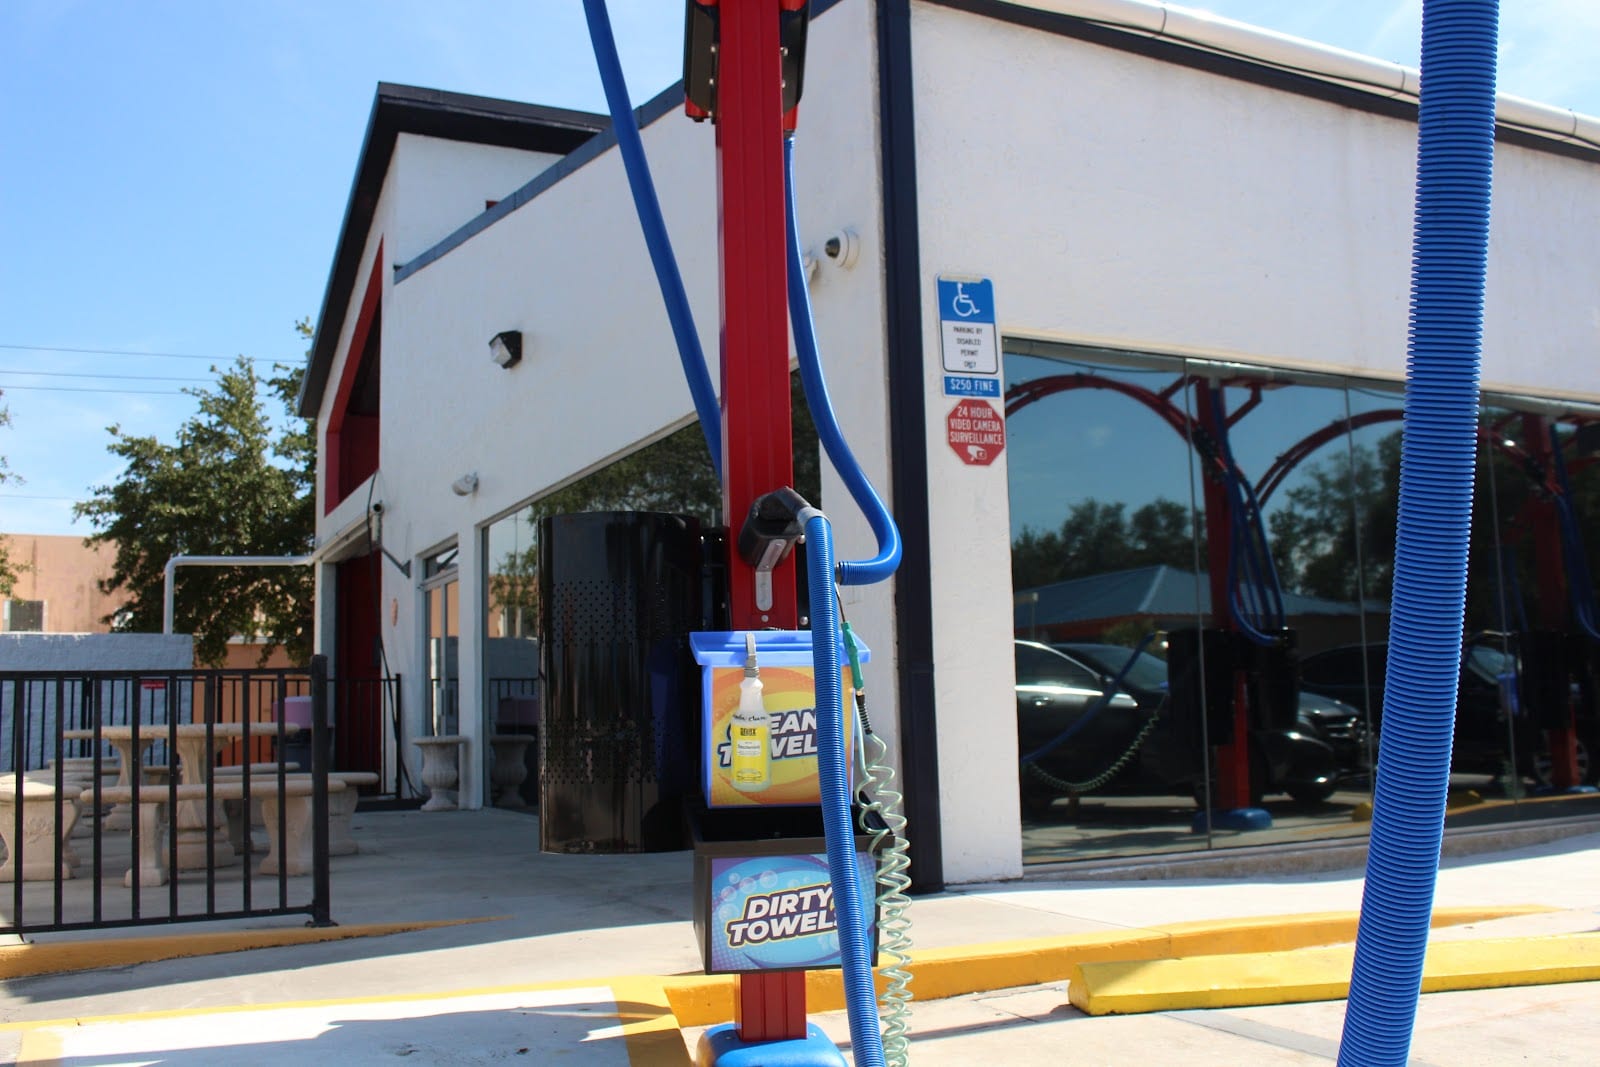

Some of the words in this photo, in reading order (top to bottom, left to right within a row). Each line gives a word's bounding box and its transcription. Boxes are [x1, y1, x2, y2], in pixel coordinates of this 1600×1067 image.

[950, 378, 972, 391] $250
[974, 380, 994, 392] FINE
[957, 406, 968, 418] 24
[970, 407, 993, 419] HOUR
[950, 418, 972, 431] VIDEO
[972, 420, 1002, 433] CAMERA
[950, 431, 1004, 446] SURVEILLANCE
[720, 734, 818, 766] TWEL
[747, 886, 833, 920] DIRTY
[730, 910, 838, 944] TOWEL
